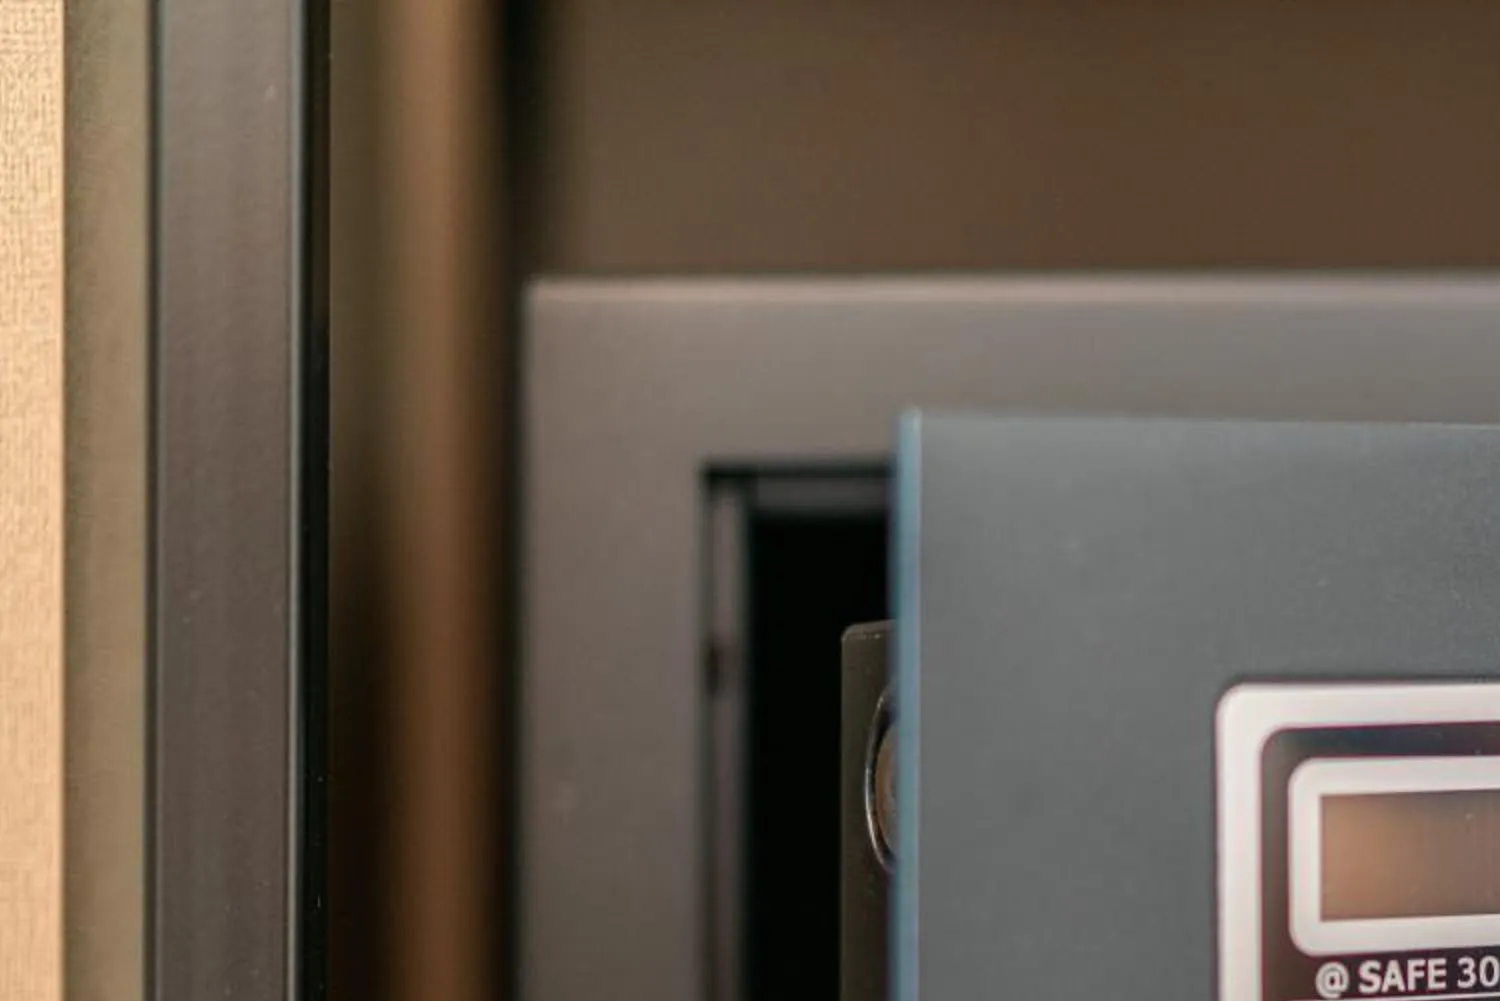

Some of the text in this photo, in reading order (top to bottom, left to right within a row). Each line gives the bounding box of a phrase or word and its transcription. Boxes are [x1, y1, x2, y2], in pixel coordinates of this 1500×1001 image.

[1315, 961, 1349, 999] @
[1358, 957, 1447, 994] SAFE
[1457, 955, 1500, 989] 30
